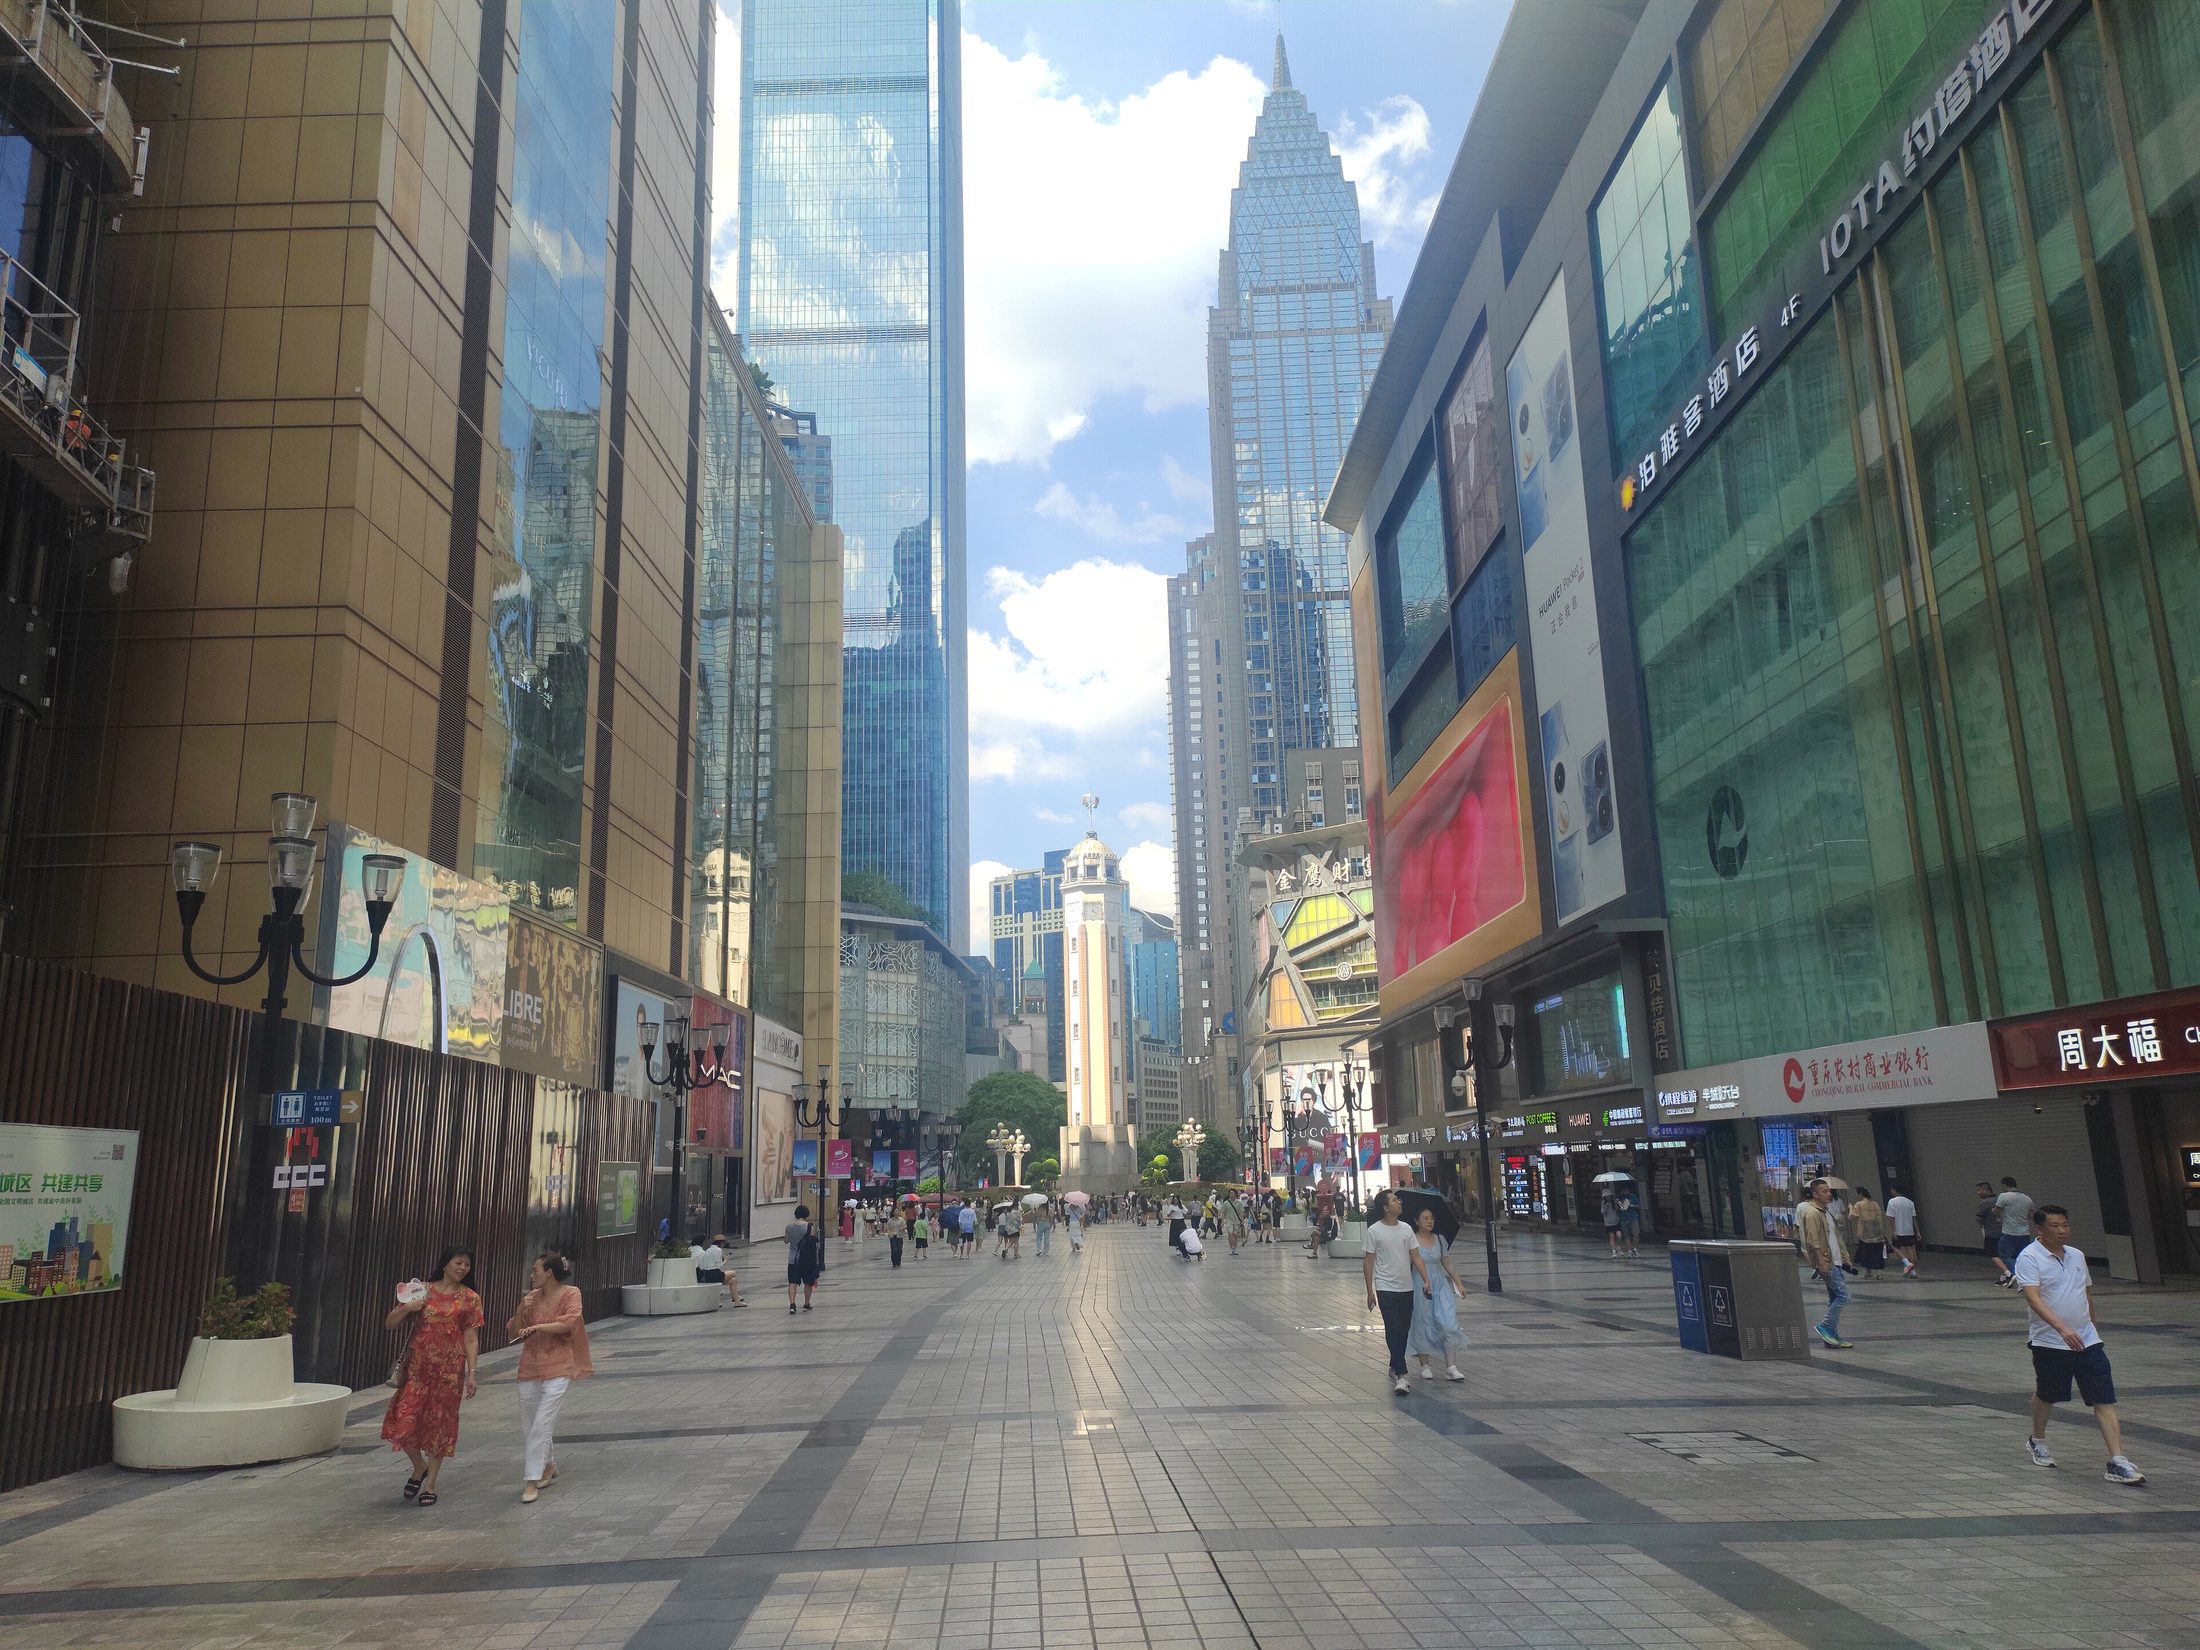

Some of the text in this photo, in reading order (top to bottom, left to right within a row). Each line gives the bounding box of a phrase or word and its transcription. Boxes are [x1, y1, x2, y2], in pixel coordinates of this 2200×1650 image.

[1820, 160, 1903, 275] IOTA
[1638, 292, 1801, 493] 泊雅客酒店 4F
[1538, 584, 1563, 618] HUAWEI
[2057, 1018, 2165, 1072] 周大福
[1807, 1046, 1930, 1087] 重庆农村商业银行
[1811, 1075, 1934, 1098] CHONGQING RURAL COMMERCIAL BANK
[311, 1116, 332, 1124] 100m
[1525, 1114, 1537, 1126] POST
[1568, 1112, 1593, 1127] HUAWEI
[41, 1173, 104, 1193] 共建共享
